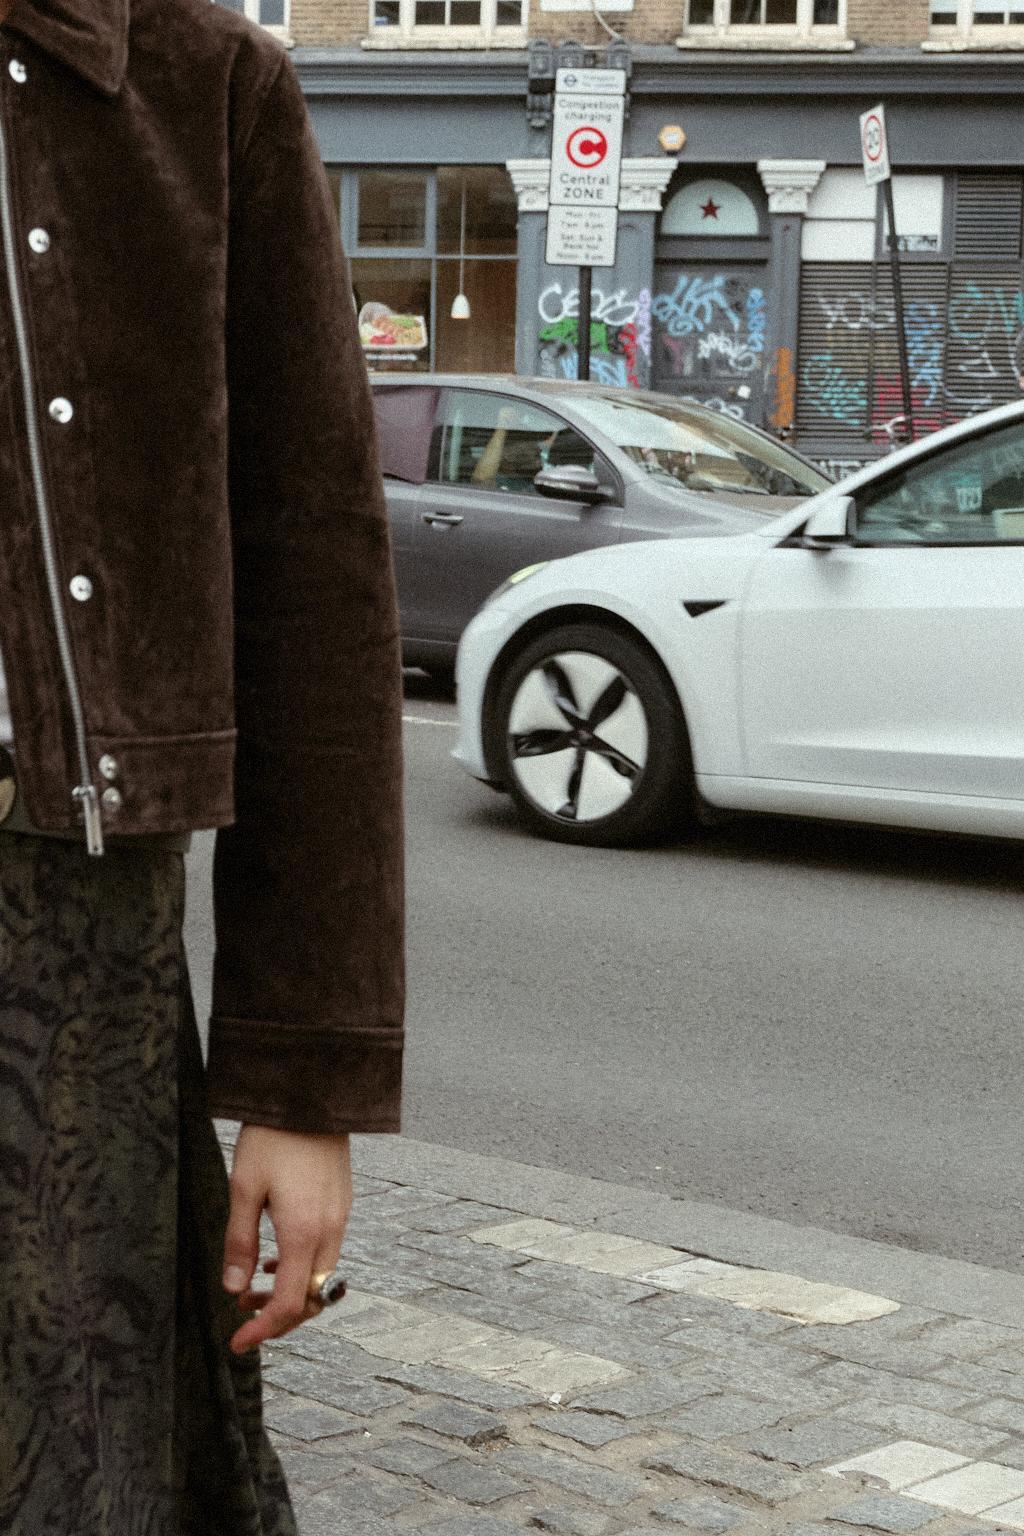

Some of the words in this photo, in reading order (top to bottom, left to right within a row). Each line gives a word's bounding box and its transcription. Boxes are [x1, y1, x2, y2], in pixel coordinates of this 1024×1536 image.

[559, 99, 619, 110] Congestion
[565, 112, 612, 122] charging
[560, 173, 610, 185] Central
[564, 187, 604, 199] ZONE
